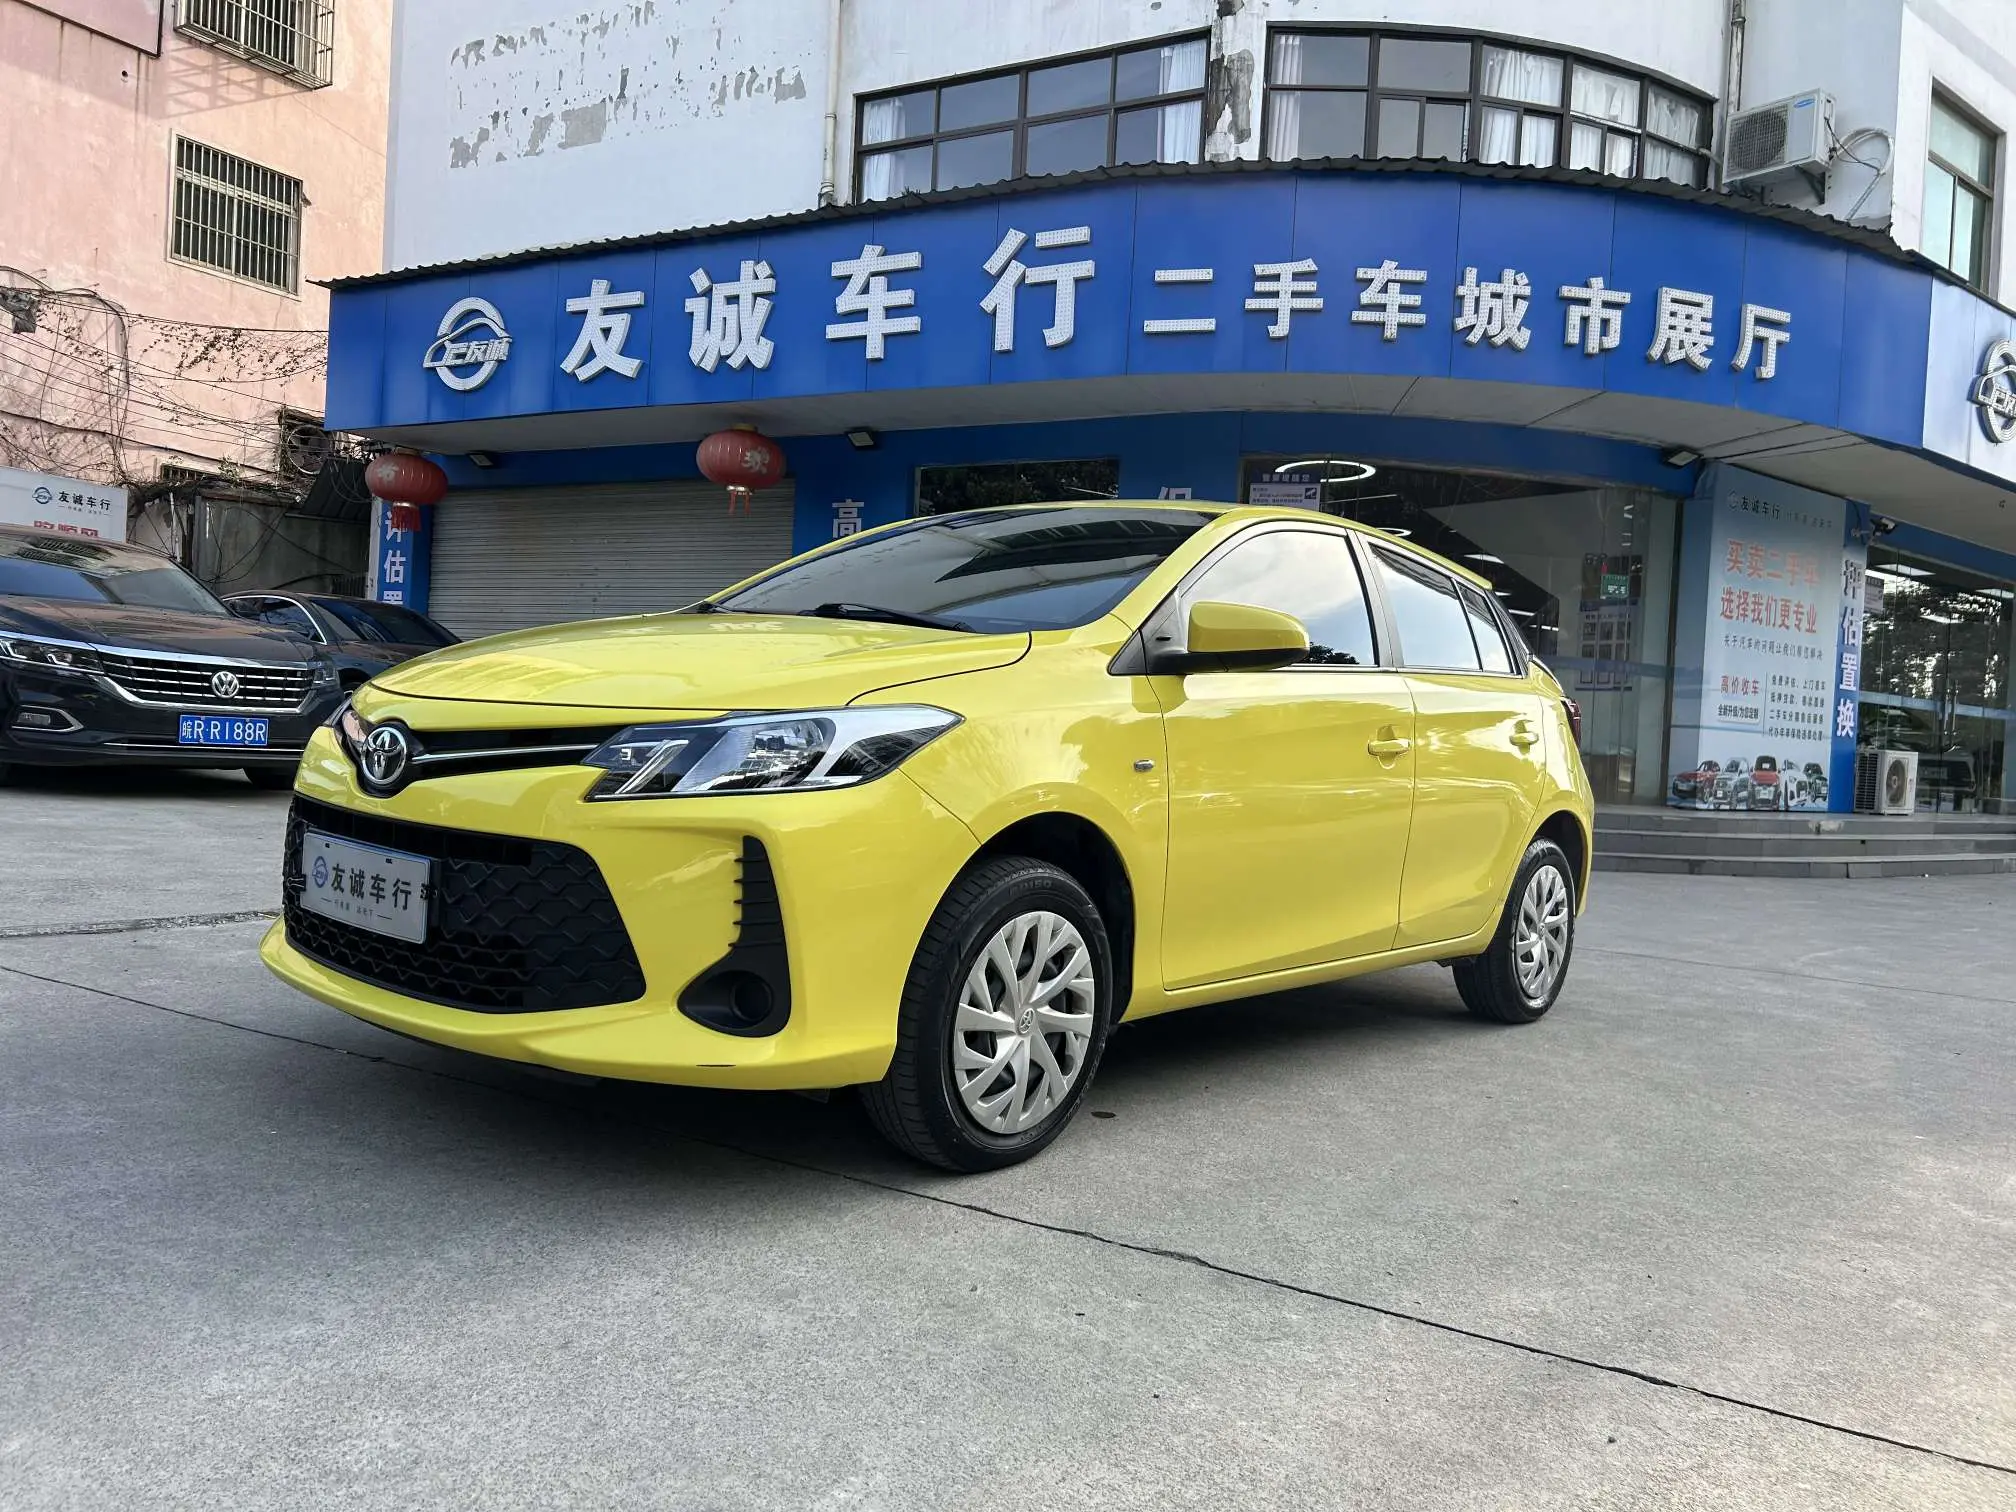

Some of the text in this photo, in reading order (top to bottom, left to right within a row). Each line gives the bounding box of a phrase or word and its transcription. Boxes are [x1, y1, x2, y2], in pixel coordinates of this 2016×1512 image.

[560, 225, 1793, 383] 友诚车行 二手车城市展厅
[58, 490, 112, 511] 友诚车行
[1740, 495, 1780, 521] 友诚车行
[1720, 586, 1818, 634] 选择我们更专业
[1836, 559, 1863, 738] 评估置换
[1720, 675, 1760, 696] 高价收车
[331, 863, 412, 911] 友诚车行
